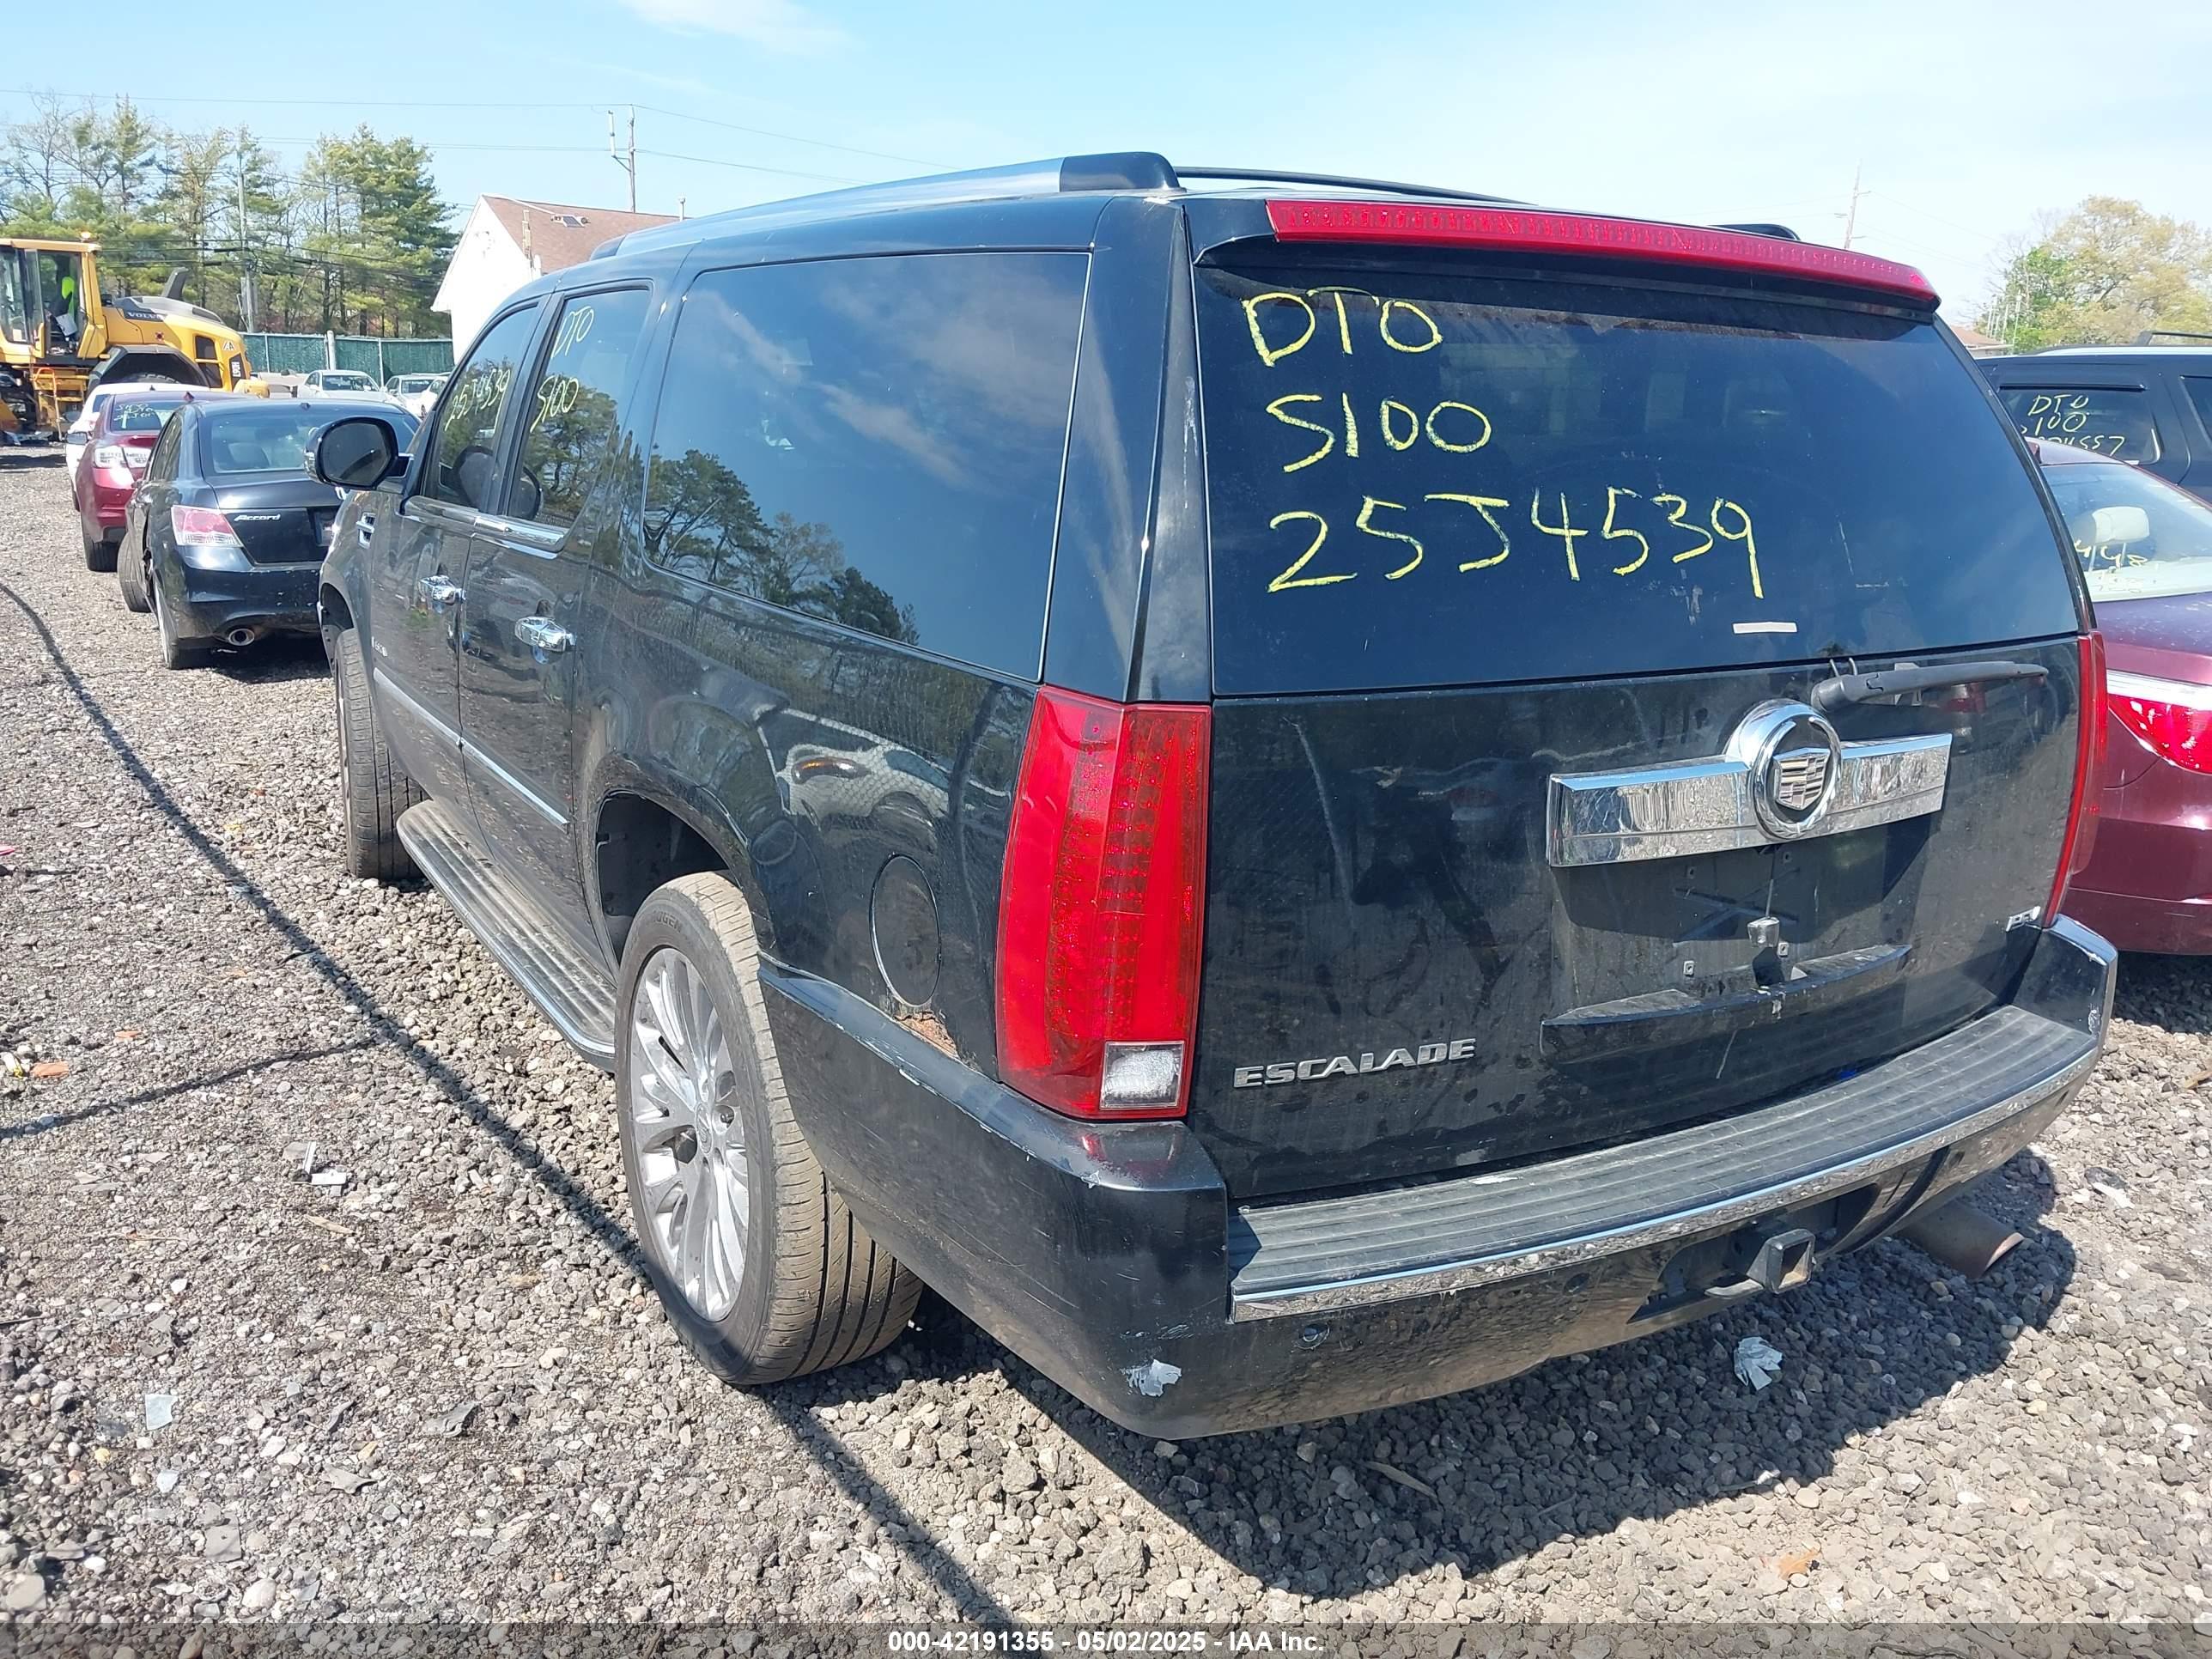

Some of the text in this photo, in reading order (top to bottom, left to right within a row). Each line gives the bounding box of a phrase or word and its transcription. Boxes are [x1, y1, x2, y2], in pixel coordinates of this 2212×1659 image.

[550, 306, 594, 361] DTO
[1242, 286, 1443, 367] DTO
[2027, 393, 2089, 416] DTO
[1266, 392, 1492, 473] S100
[234, 514, 281, 522] Accord
[1267, 486, 1763, 599] 25J4539
[1233, 1037, 1476, 1088] ESCALADE
